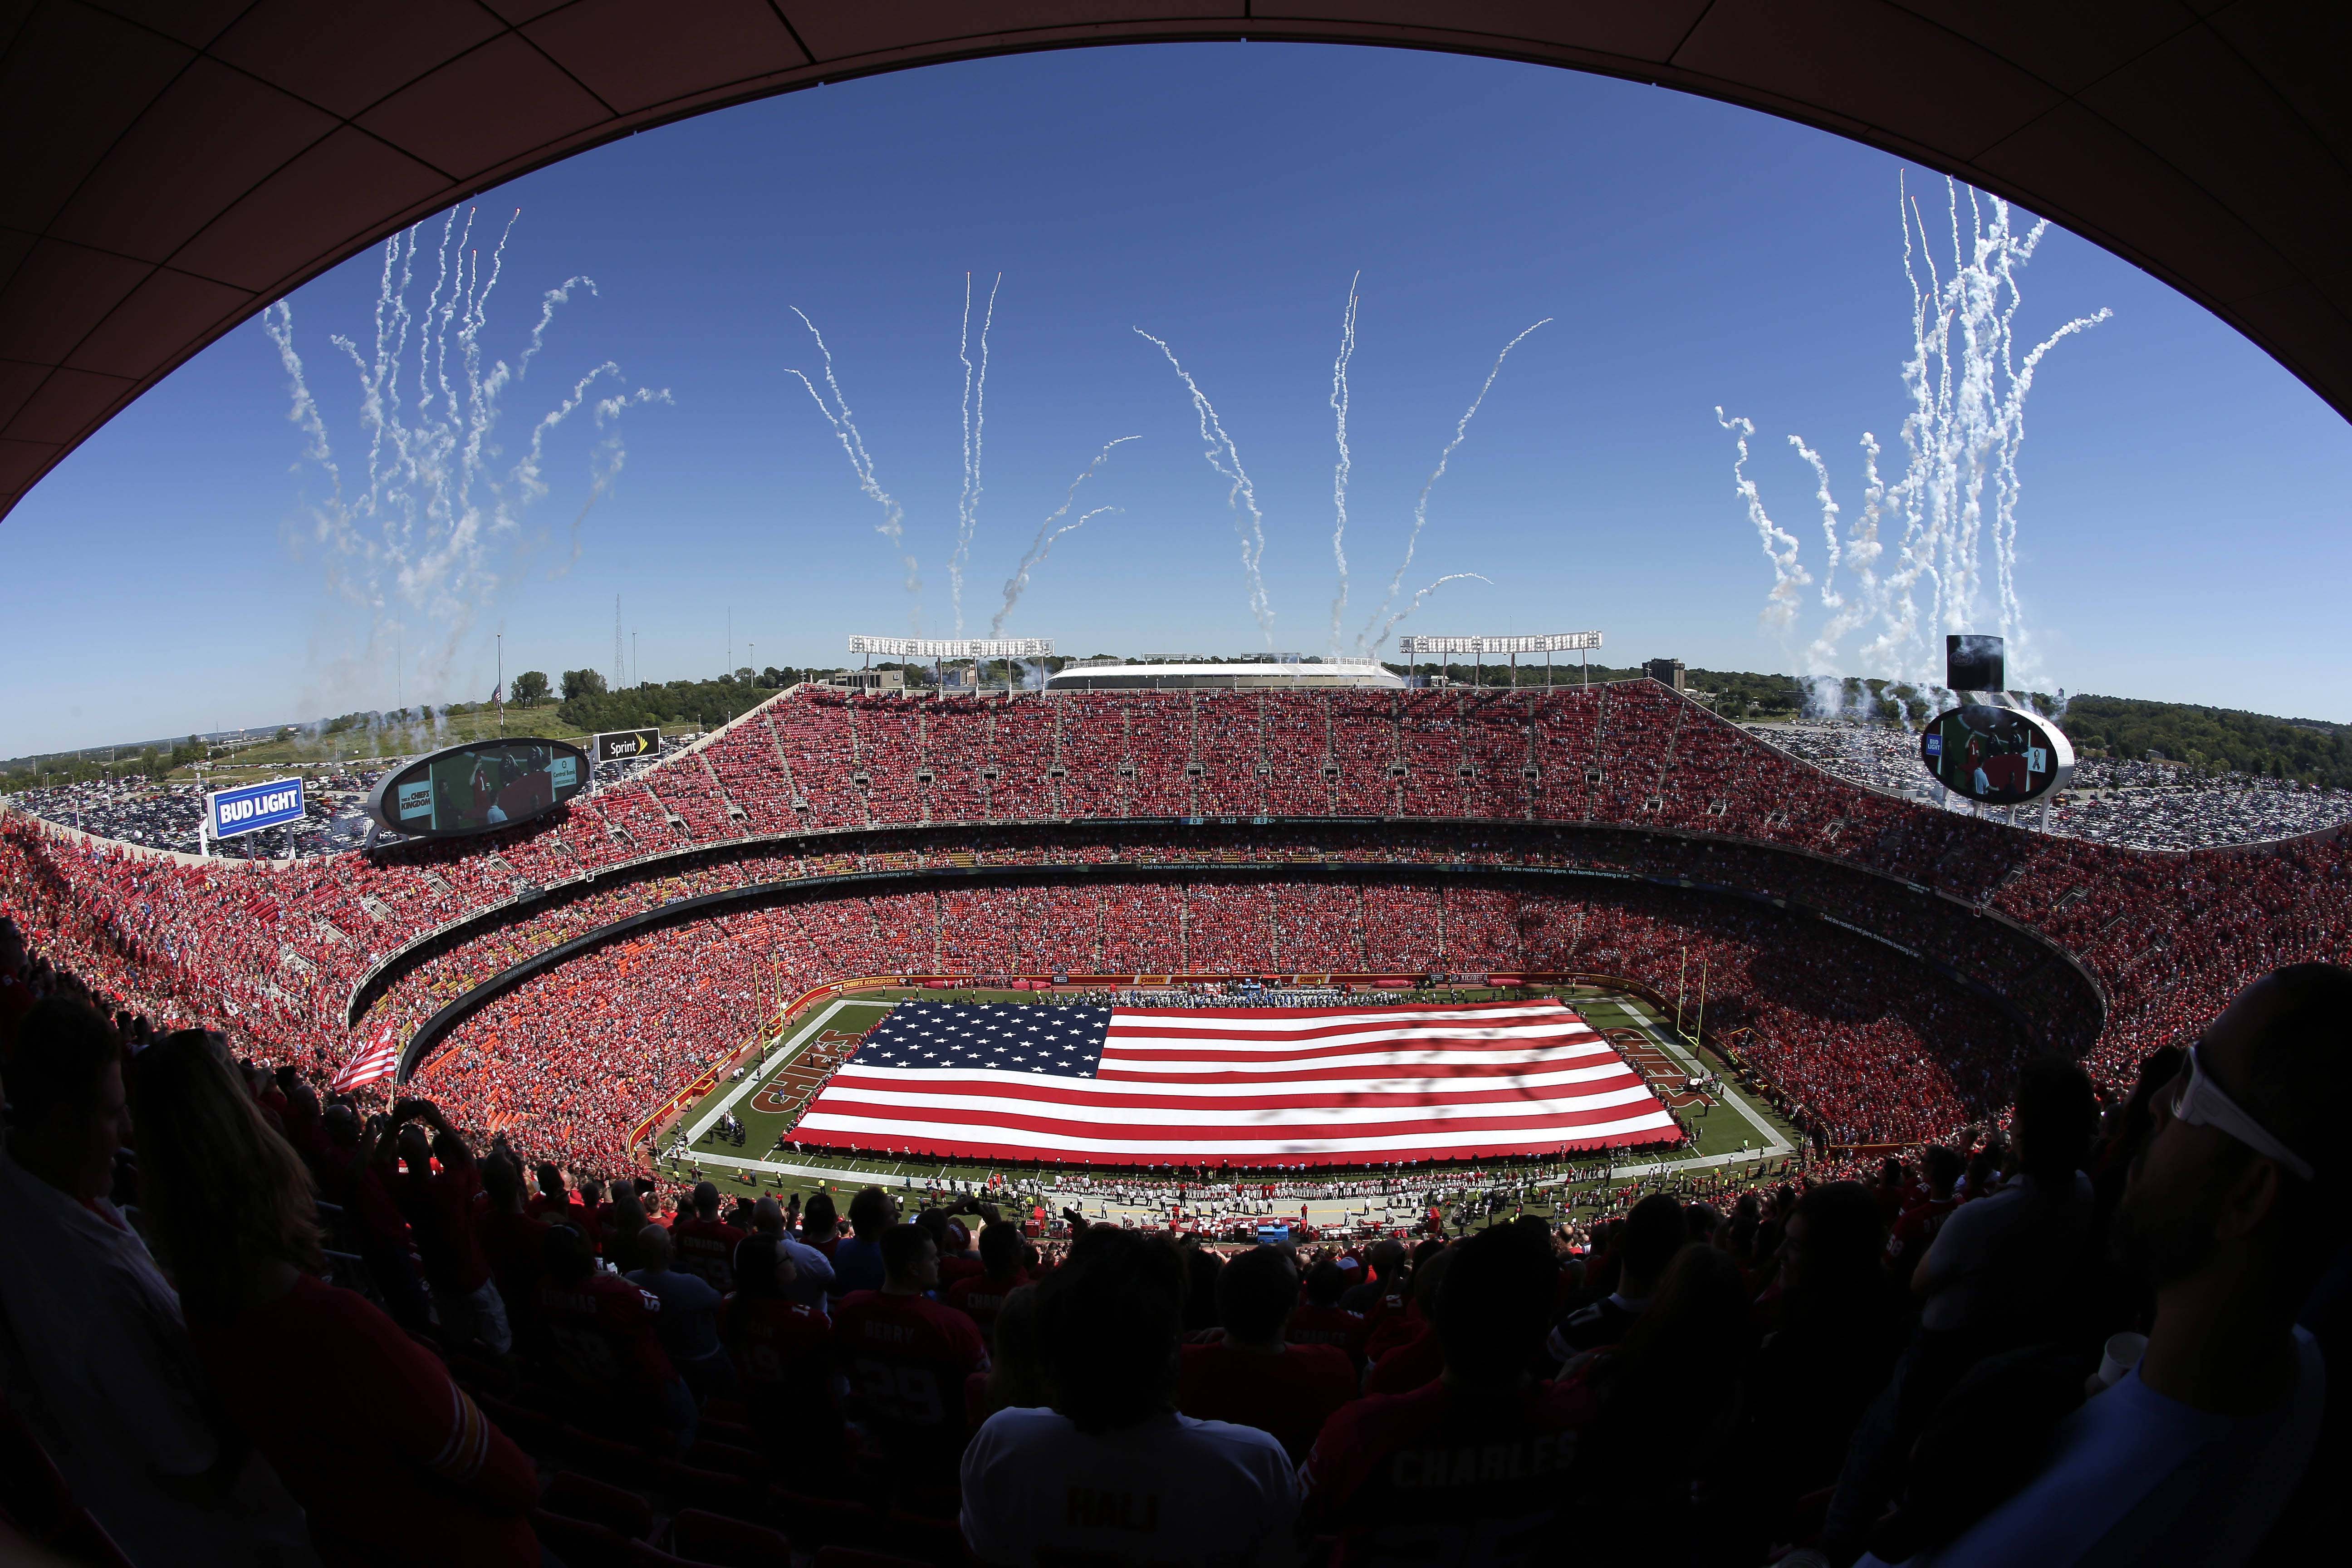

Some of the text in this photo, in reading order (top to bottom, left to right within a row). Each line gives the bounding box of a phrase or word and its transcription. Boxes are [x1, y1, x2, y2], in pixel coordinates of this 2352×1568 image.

[611, 740, 636, 757] Sprint
[220, 790, 298, 824] BUD LIGHT
[401, 798, 431, 810] KINGDOM
[411, 790, 430, 800] CHIEFS
[450, 920, 461, 928] TAYLOR
[573, 937, 589, 948] bursting
[1839, 921, 1855, 931] rocket's
[1880, 936, 1893, 946] bombs
[1893, 941, 1909, 955] bursting
[750, 1029, 863, 1113] CHIEFS
[683, 1235, 727, 1252] EDWARDS
[864, 1319, 916, 1343] BERRY
[853, 1358, 946, 1425] 29
[1392, 1429, 1578, 1488] CHARLES
[1067, 1487, 1155, 1533] HALI
